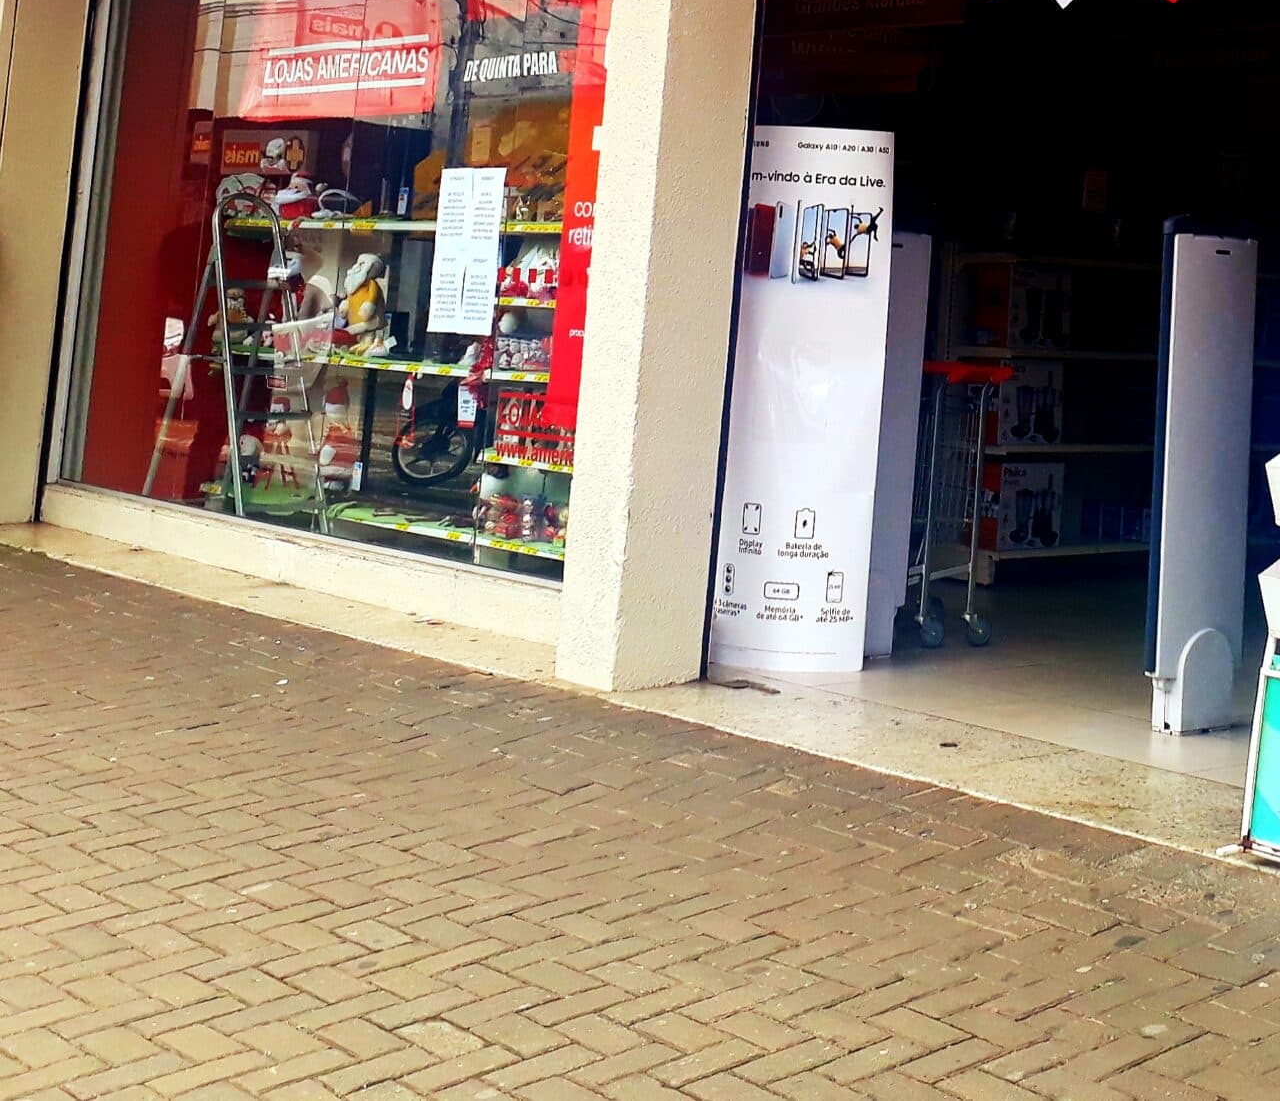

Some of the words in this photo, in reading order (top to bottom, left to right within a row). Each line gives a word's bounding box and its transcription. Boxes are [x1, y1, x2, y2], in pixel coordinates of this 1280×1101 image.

[264, 57, 313, 84] LOJAS
[463, 59, 481, 82] DE
[479, 53, 521, 83] QUINTA
[523, 50, 558, 77] PARA
[797, 141, 824, 151] Galaxy
[825, 142, 838, 150] A10
[842, 144, 856, 152] A20
[861, 145, 874, 153] A30
[751, 169, 800, 183] m-vindo
[803, 171, 813, 184] à
[815, 173, 837, 186] Era
[839, 174, 857, 186] da
[859, 175, 887, 188] Live.
[568, 226, 593, 247] reti
[738, 538, 763, 549] Display
[785, 541, 812, 550] Bateria
[813, 542, 823, 551] de
[777, 549, 798, 559] longa
[799, 549, 829, 560] duração
[722, 600, 747, 611] câmeras
[764, 604, 796, 614] Memória
[820, 606, 840, 616] Selfie
[842, 608, 851, 616] de
[766, 613, 777, 621] até
[815, 615, 827, 623] até
